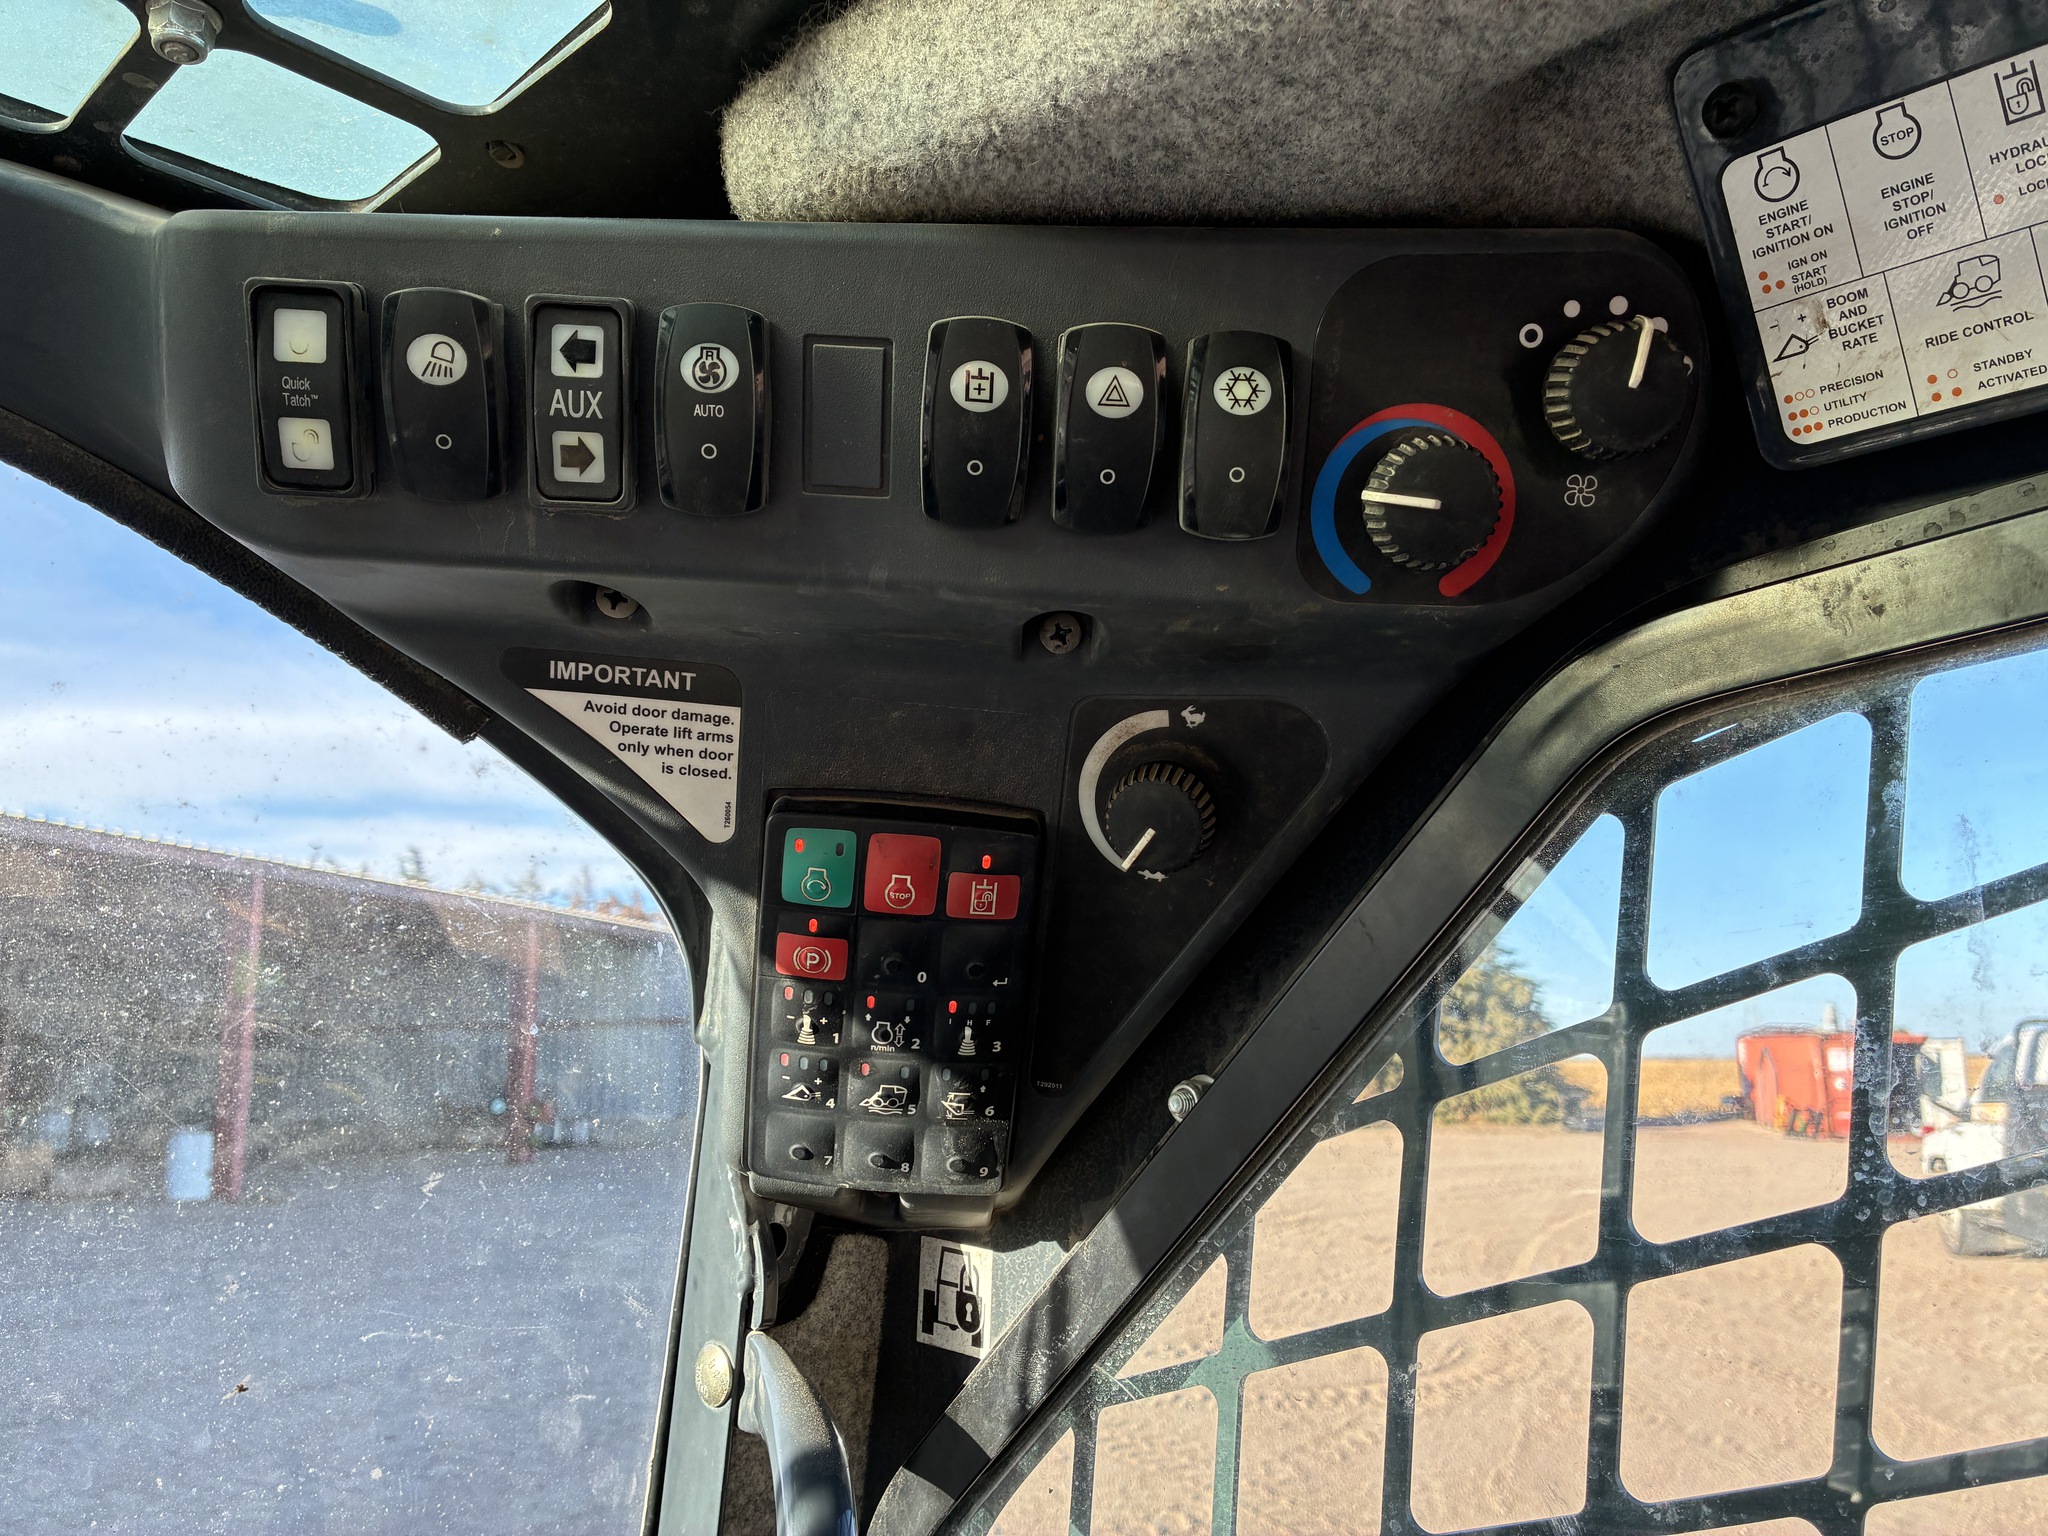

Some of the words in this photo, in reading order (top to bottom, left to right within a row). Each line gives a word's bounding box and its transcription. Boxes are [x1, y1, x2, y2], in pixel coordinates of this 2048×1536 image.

[1880, 127, 1914, 146] STOP
[2015, 153, 2048, 174] LOC
[1881, 172, 1935, 199] ENGINE
[1892, 189, 1934, 212] STOP/
[1758, 200, 1809, 226] ENGINE
[1884, 202, 1947, 231] IGNITION
[1766, 214, 1812, 239] START/
[1906, 223, 1934, 240] OFF
[1752, 232, 1810, 260] IGNITION
[1813, 223, 1834, 238] ON
[1787, 256, 1808, 271] IGN
[1810, 250, 1828, 263] ON
[1791, 265, 1828, 284] START
[1793, 277, 1828, 295] (HOLD)
[1826, 288, 1869, 309] BOOM
[1839, 304, 1868, 321] AND
[1828, 314, 1884, 340] BUCKET
[1925, 330, 1960, 349] RIDE
[1962, 311, 2035, 338] CONTROL
[1842, 332, 1878, 351] RATE
[1973, 348, 2033, 372] STANDBY
[281, 376, 311, 390] Quick
[1819, 369, 1884, 395] PRECISION
[1977, 364, 2048, 391] ACTIVATED
[549, 388, 604, 420] AUX
[693, 404, 725, 418] AUTO
[1823, 391, 1868, 412] UTILITY
[1828, 400, 1907, 428] PRODUCTION
[549, 659, 697, 691] IMPORTANT
[583, 700, 627, 716] Avoid
[631, 704, 667, 719] door
[671, 708, 735, 727] damage.
[609, 720, 669, 737] Operate
[673, 725, 692, 740] lift
[696, 731, 734, 744] arms
[617, 740, 650, 757] only
[654, 744, 694, 758] when
[698, 747, 734, 762] door
[661, 762, 674, 775] is
[678, 764, 732, 780] closed.
[889, 891, 911, 900] STOP
[916, 971, 927, 984] 0
[832, 1032, 839, 1044] 1
[870, 1043, 895, 1053] n/min
[910, 1038, 921, 1050] 2
[992, 1041, 1002, 1053] 3
[825, 1098, 836, 1109] 4
[907, 1104, 917, 1115] 5
[984, 1106, 995, 1117] 6
[823, 1155, 833, 1166] 7
[900, 1162, 910, 1173] 8
[978, 1166, 989, 1178] 9
